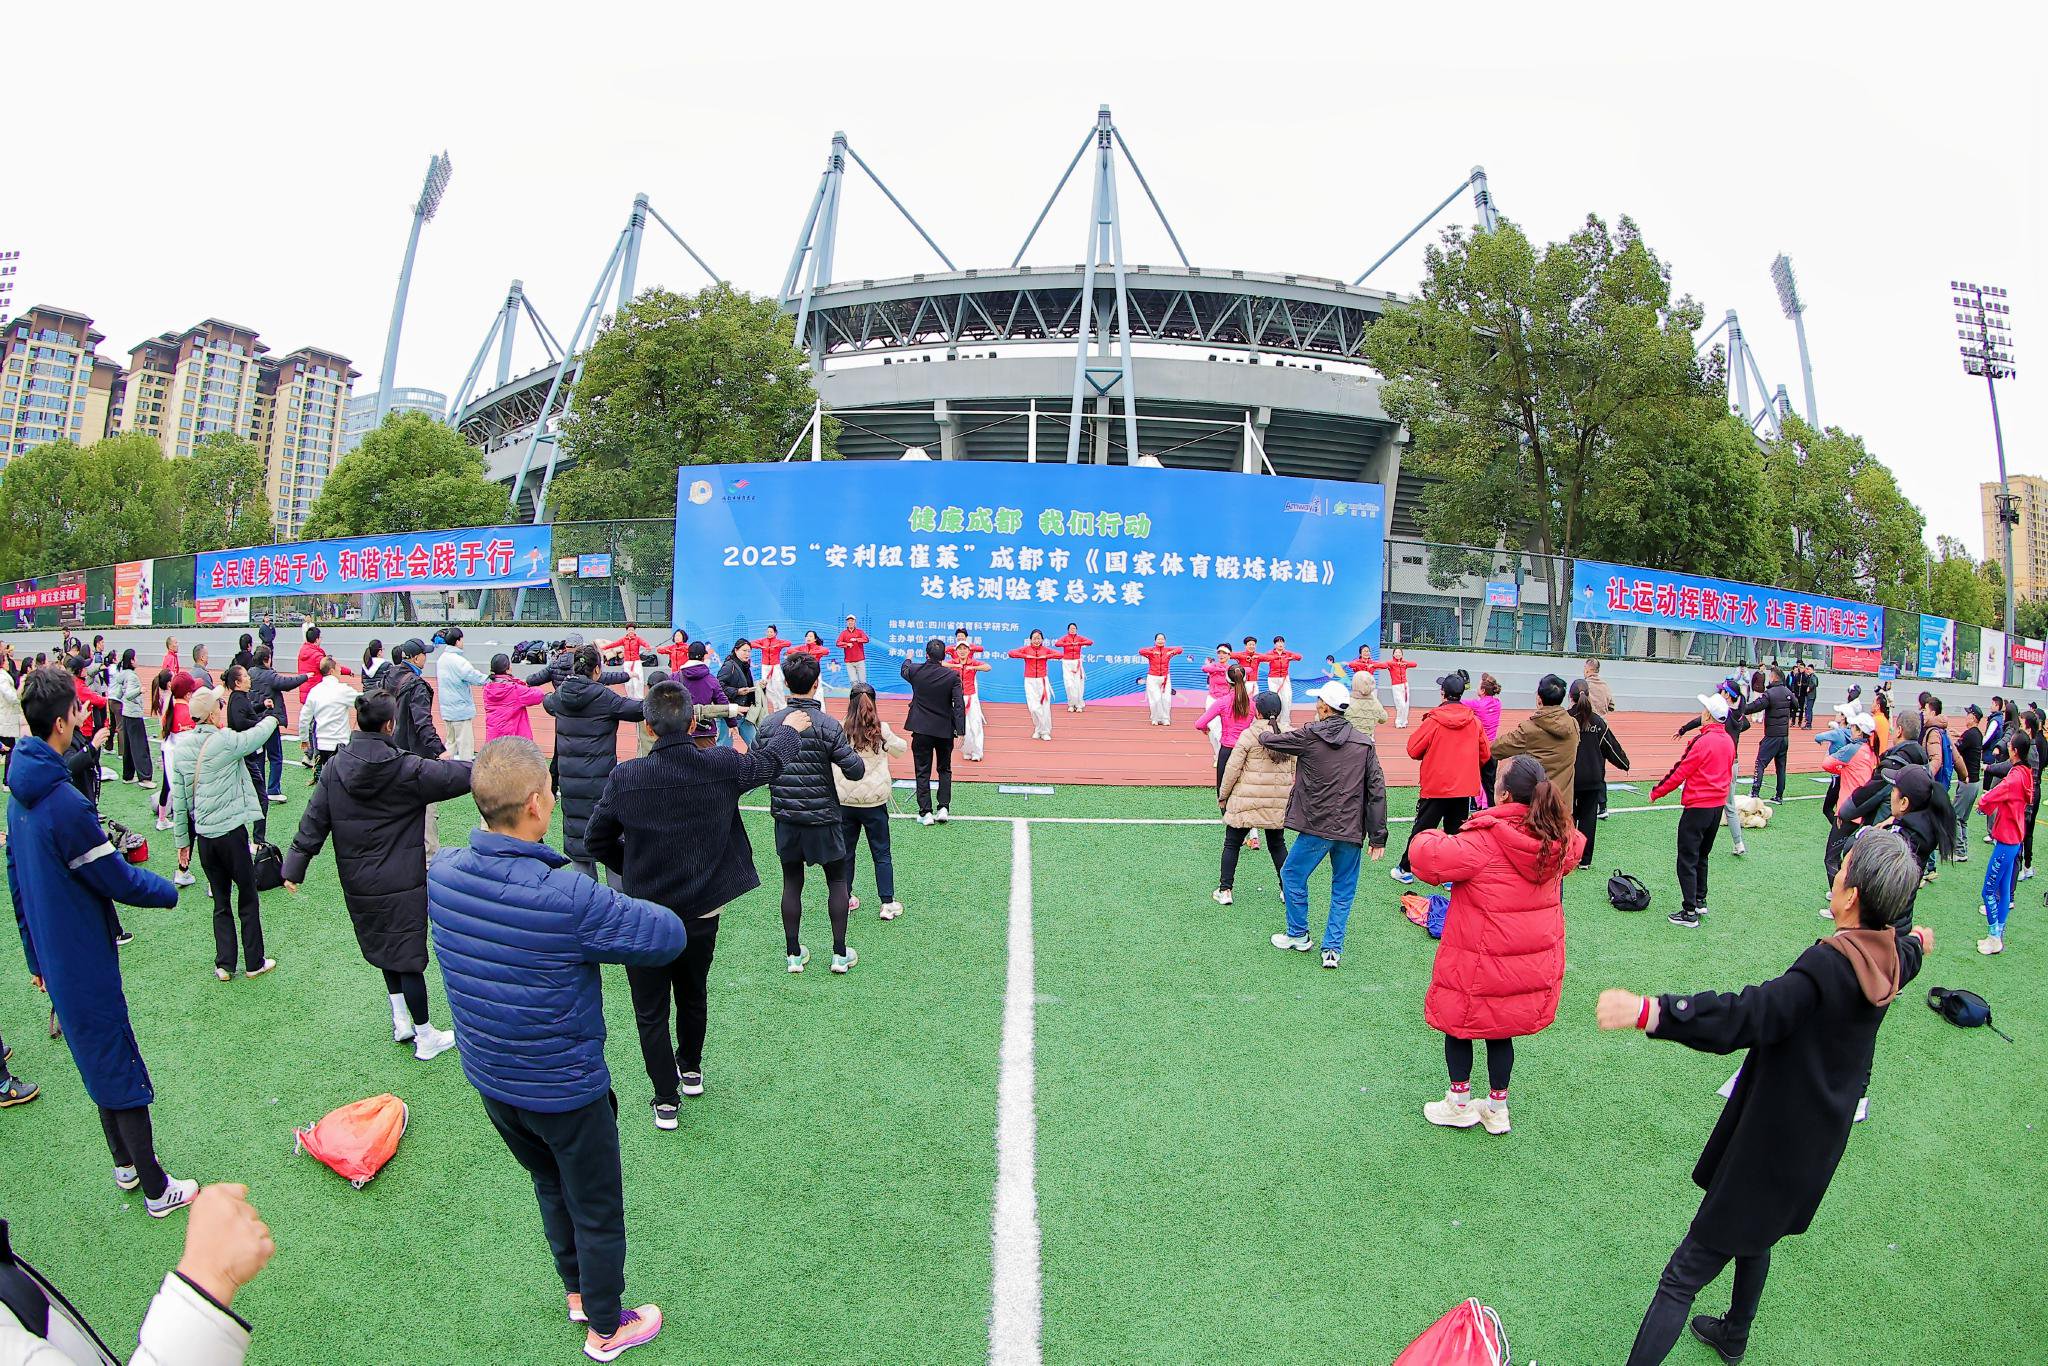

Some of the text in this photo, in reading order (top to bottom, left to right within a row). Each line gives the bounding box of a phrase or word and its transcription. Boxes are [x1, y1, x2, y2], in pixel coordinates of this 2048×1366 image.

[907, 506, 1152, 539] 健康成都 我们行动
[211, 539, 516, 589] 全民健身始于心 和谐社会践于行
[920, 575, 1146, 606] 达标测验赛总决赛
[1606, 575, 1869, 639] 让运动挥散汗水 让青春闪耀光芒
